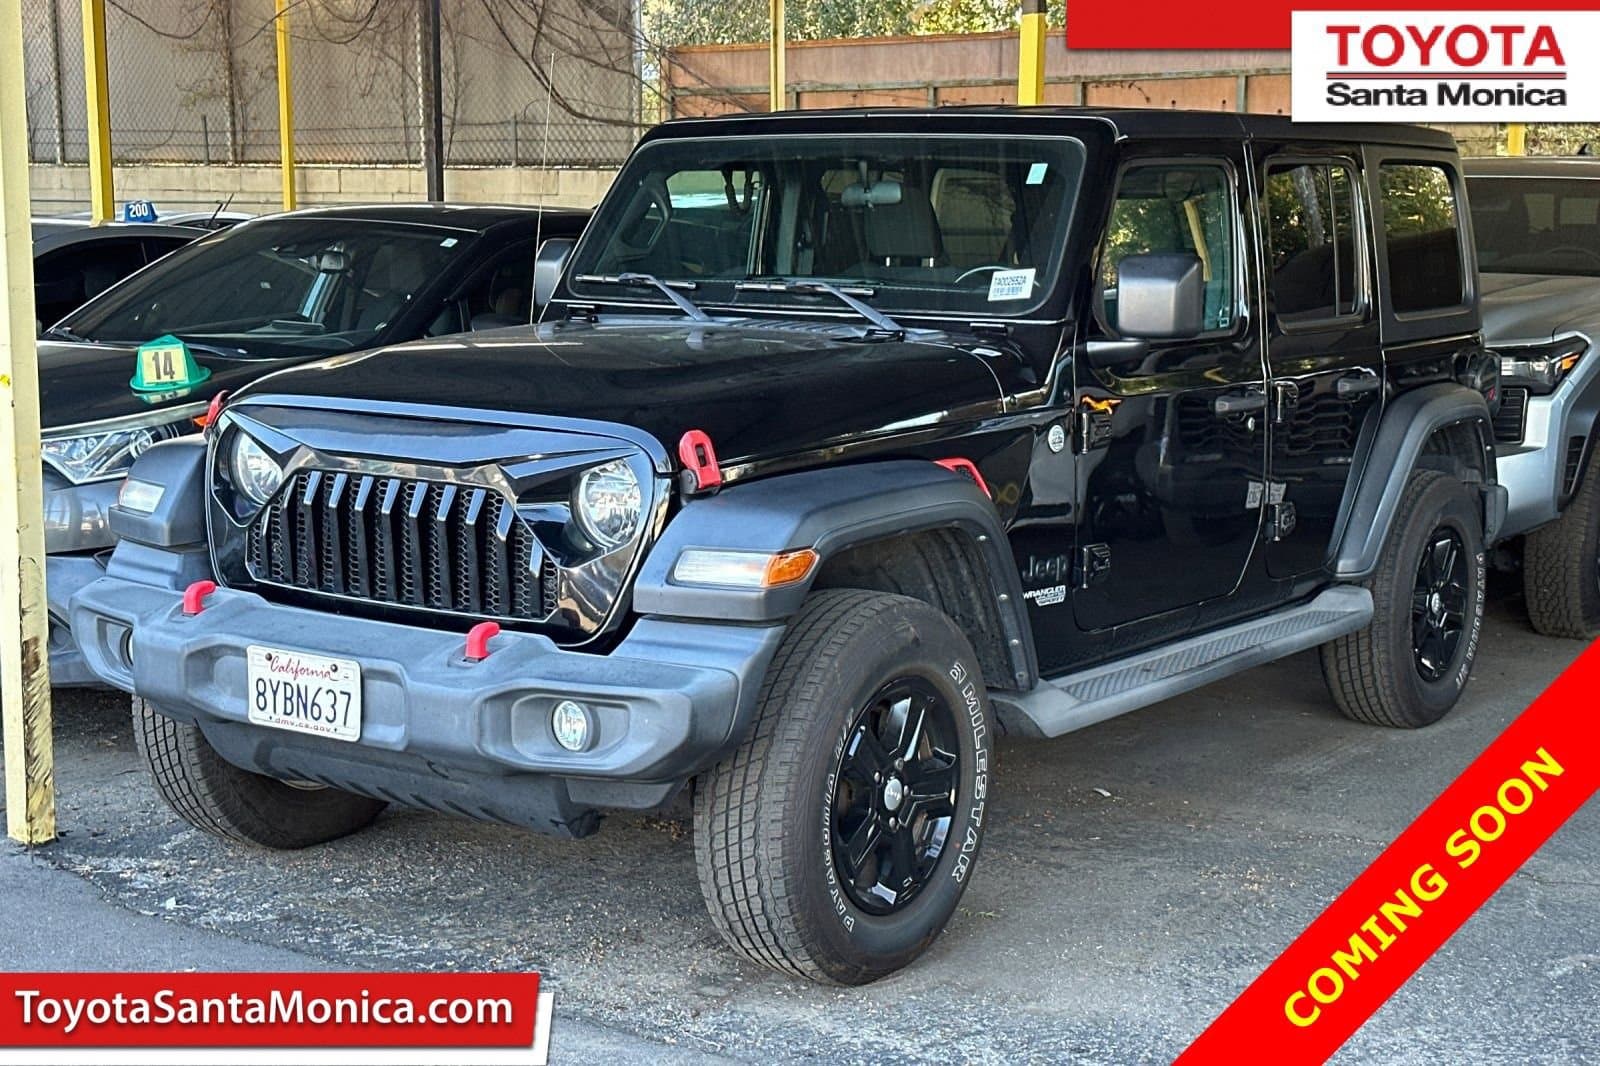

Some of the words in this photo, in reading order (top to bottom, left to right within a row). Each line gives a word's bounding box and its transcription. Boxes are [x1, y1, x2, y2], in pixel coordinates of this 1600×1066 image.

[128, 203, 149, 218] 200
[152, 351, 175, 380] 14
[1022, 555, 1068, 582] Jeep
[270, 655, 339, 681] California
[256, 677, 352, 728] 8YBN637
[952, 682, 988, 883] MILESTAR
